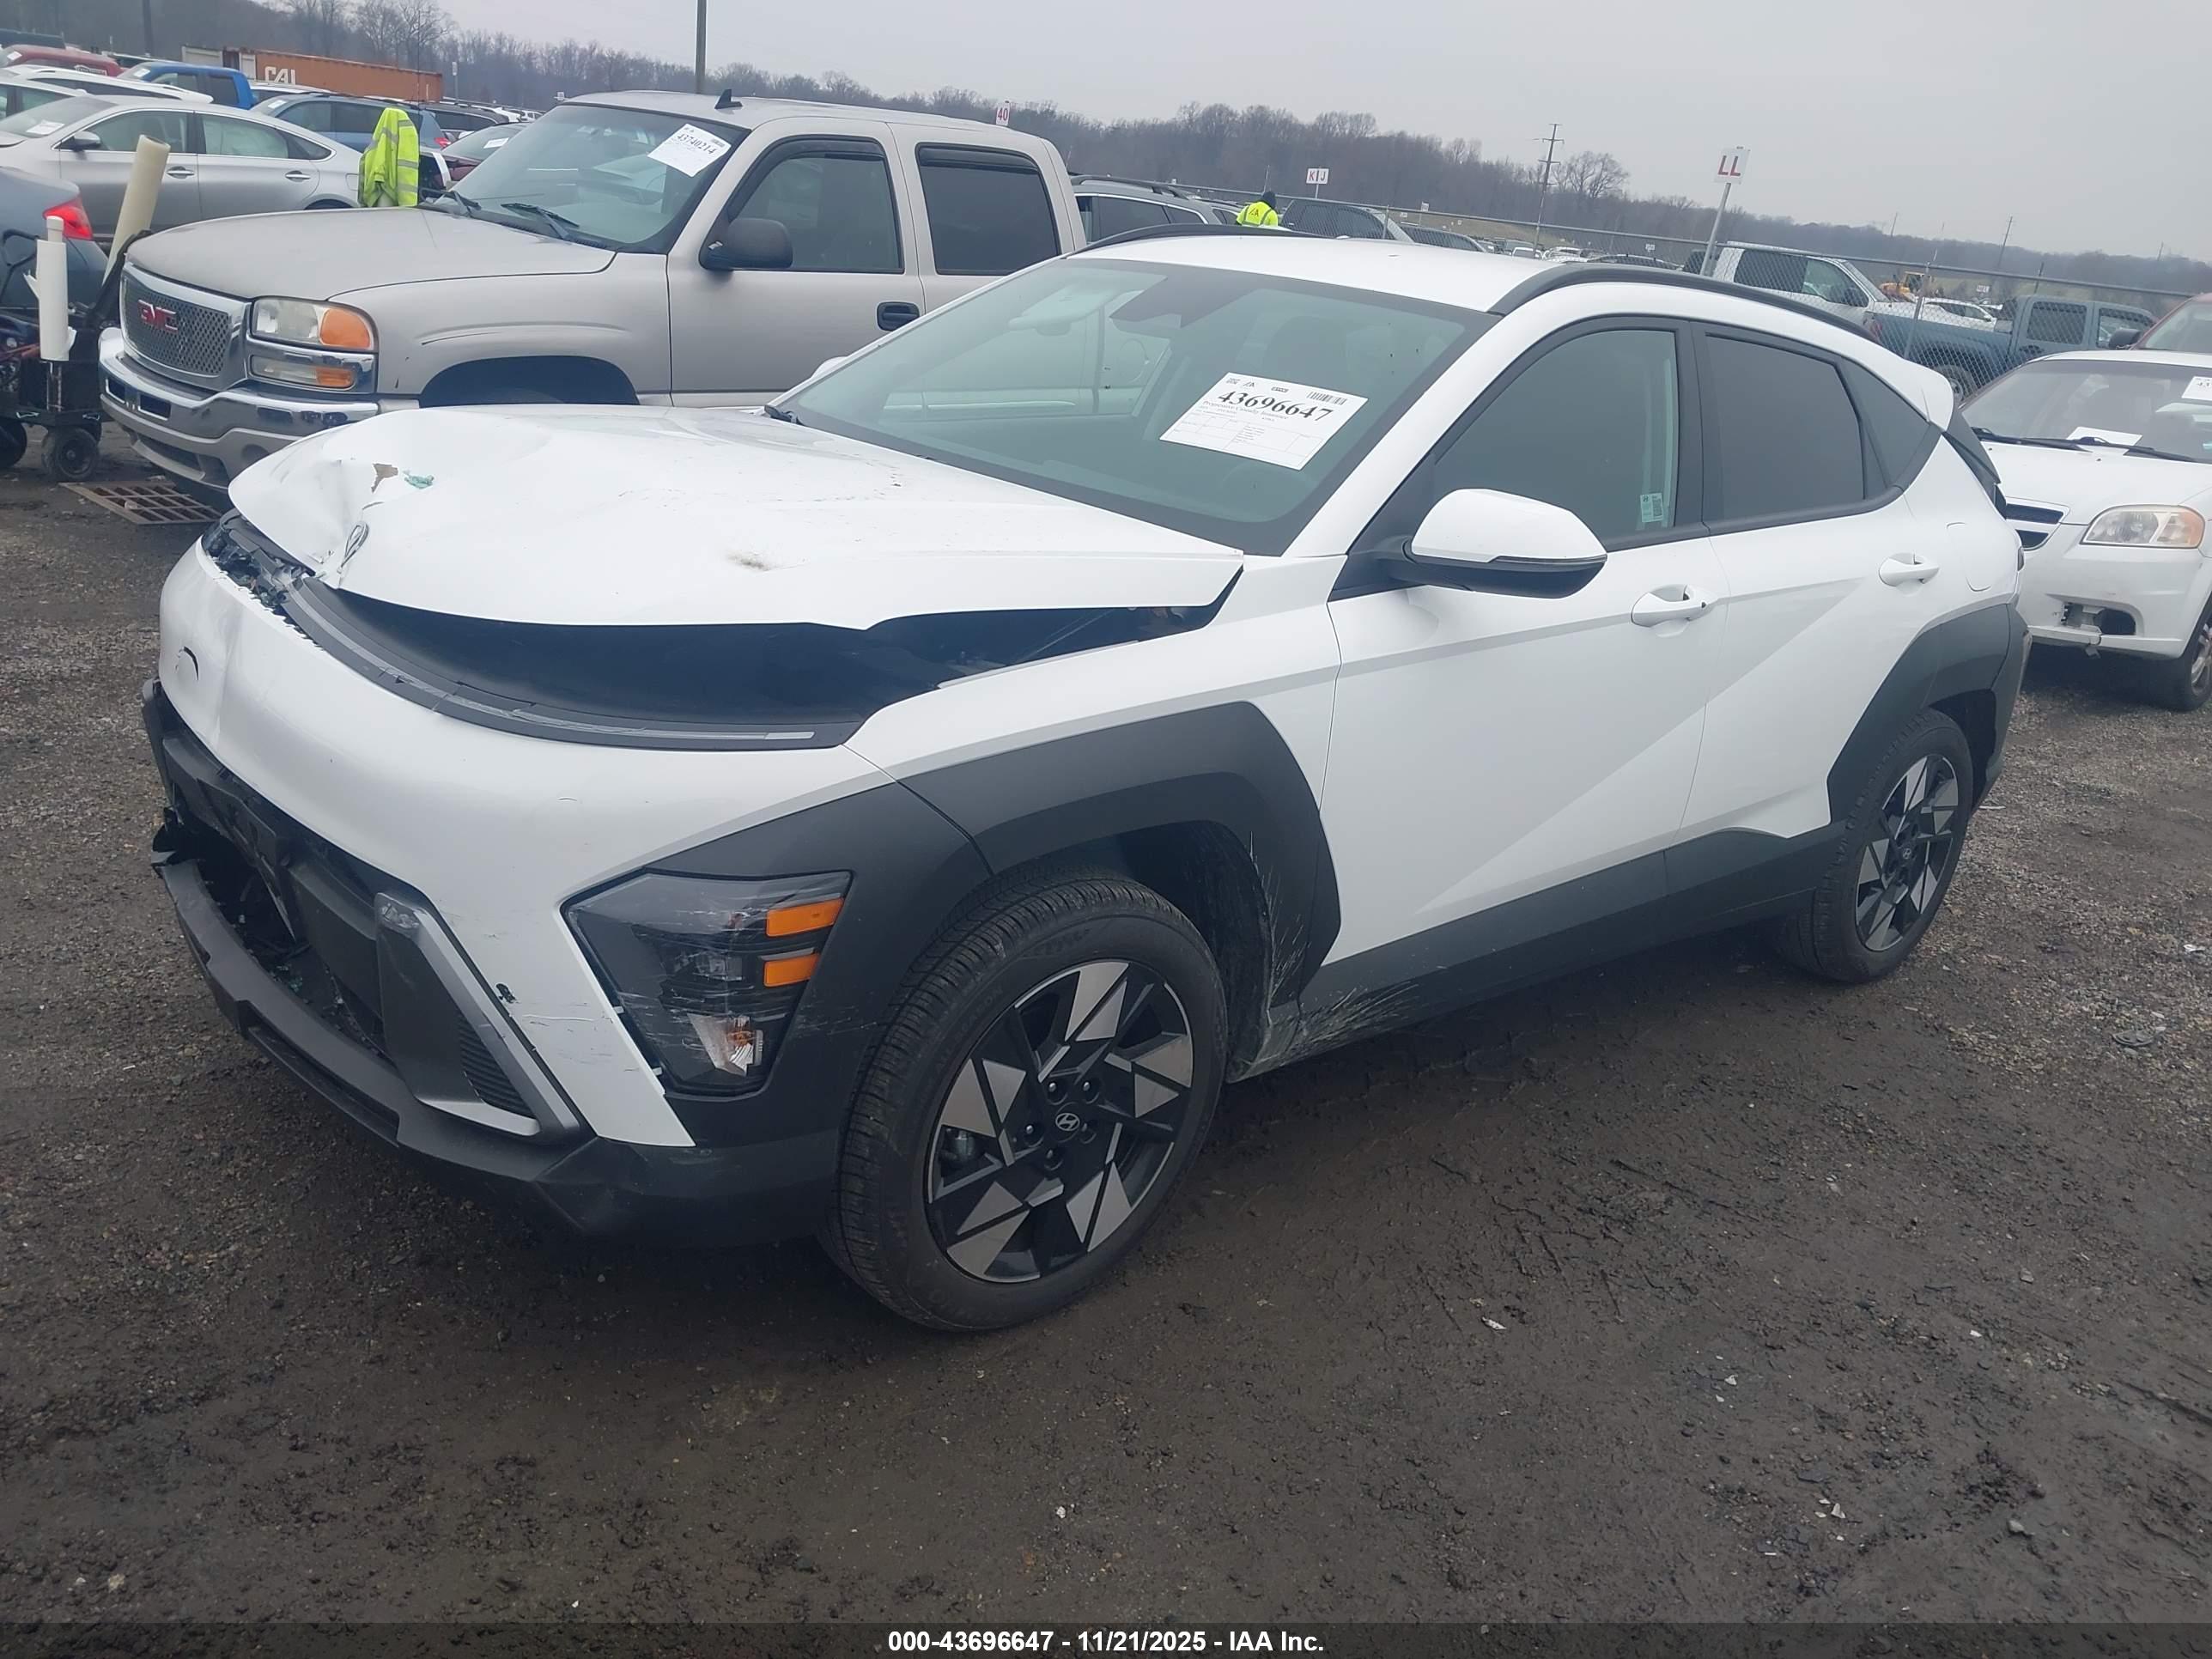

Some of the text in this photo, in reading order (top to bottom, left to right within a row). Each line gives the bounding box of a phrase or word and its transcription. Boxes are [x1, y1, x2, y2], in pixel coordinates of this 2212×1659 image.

[997, 107, 1008, 121] 40
[677, 133, 717, 155] 43740214
[1717, 155, 1741, 177] LL
[137, 299, 179, 333] GMC
[1217, 391, 1334, 422] 43696647
